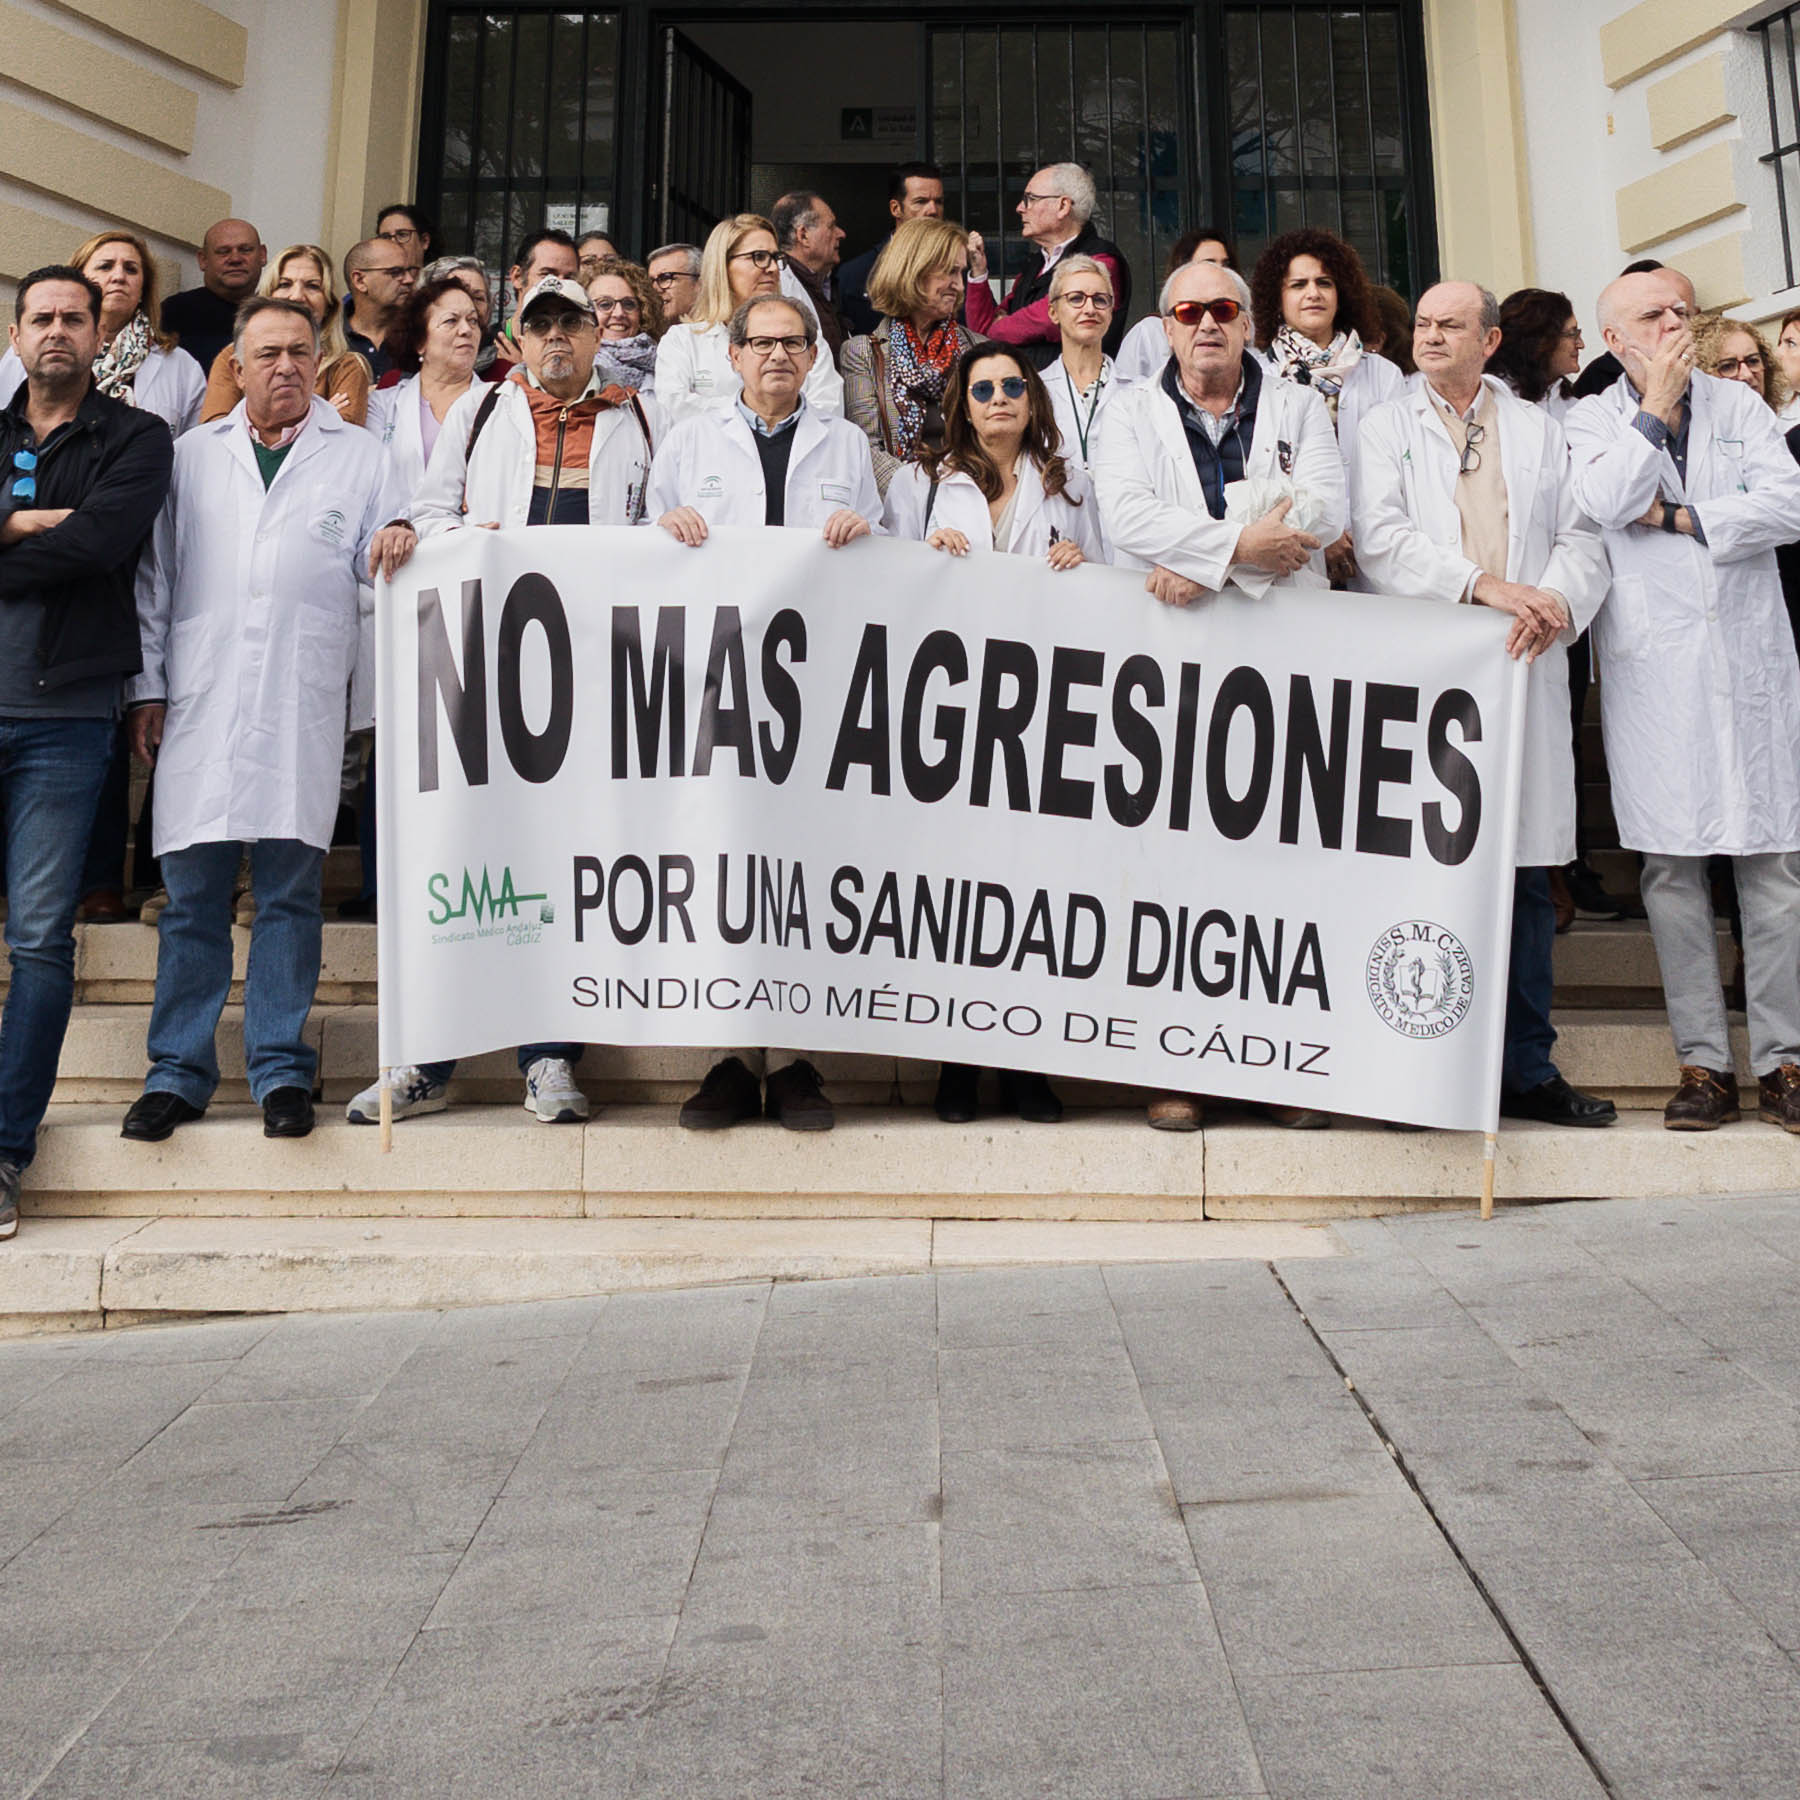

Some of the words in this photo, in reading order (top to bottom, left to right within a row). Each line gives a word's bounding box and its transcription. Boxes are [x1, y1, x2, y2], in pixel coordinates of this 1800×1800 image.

[416, 571, 574, 793] NO
[611, 605, 807, 786] MAS
[824, 622, 1483, 866] AGRESIONES
[431, 931, 475, 945] Sindicato
[573, 853, 697, 946] POR
[716, 852, 812, 951] UNA
[824, 864, 1107, 980] SANIDAD
[1126, 899, 1332, 1012] DIGNA
[1369, 937, 1394, 1021] SINDICATO
[1451, 946, 1473, 995] CADIZ
[571, 975, 812, 1015] SINDICATO
[825, 982, 1043, 1037] MÉDICO
[1063, 1011, 1138, 1051] DE
[1158, 1023, 1331, 1077] CÁDIZ
[1394, 1015, 1455, 1036] MEDICO
[1451, 996, 1469, 1020] DE
